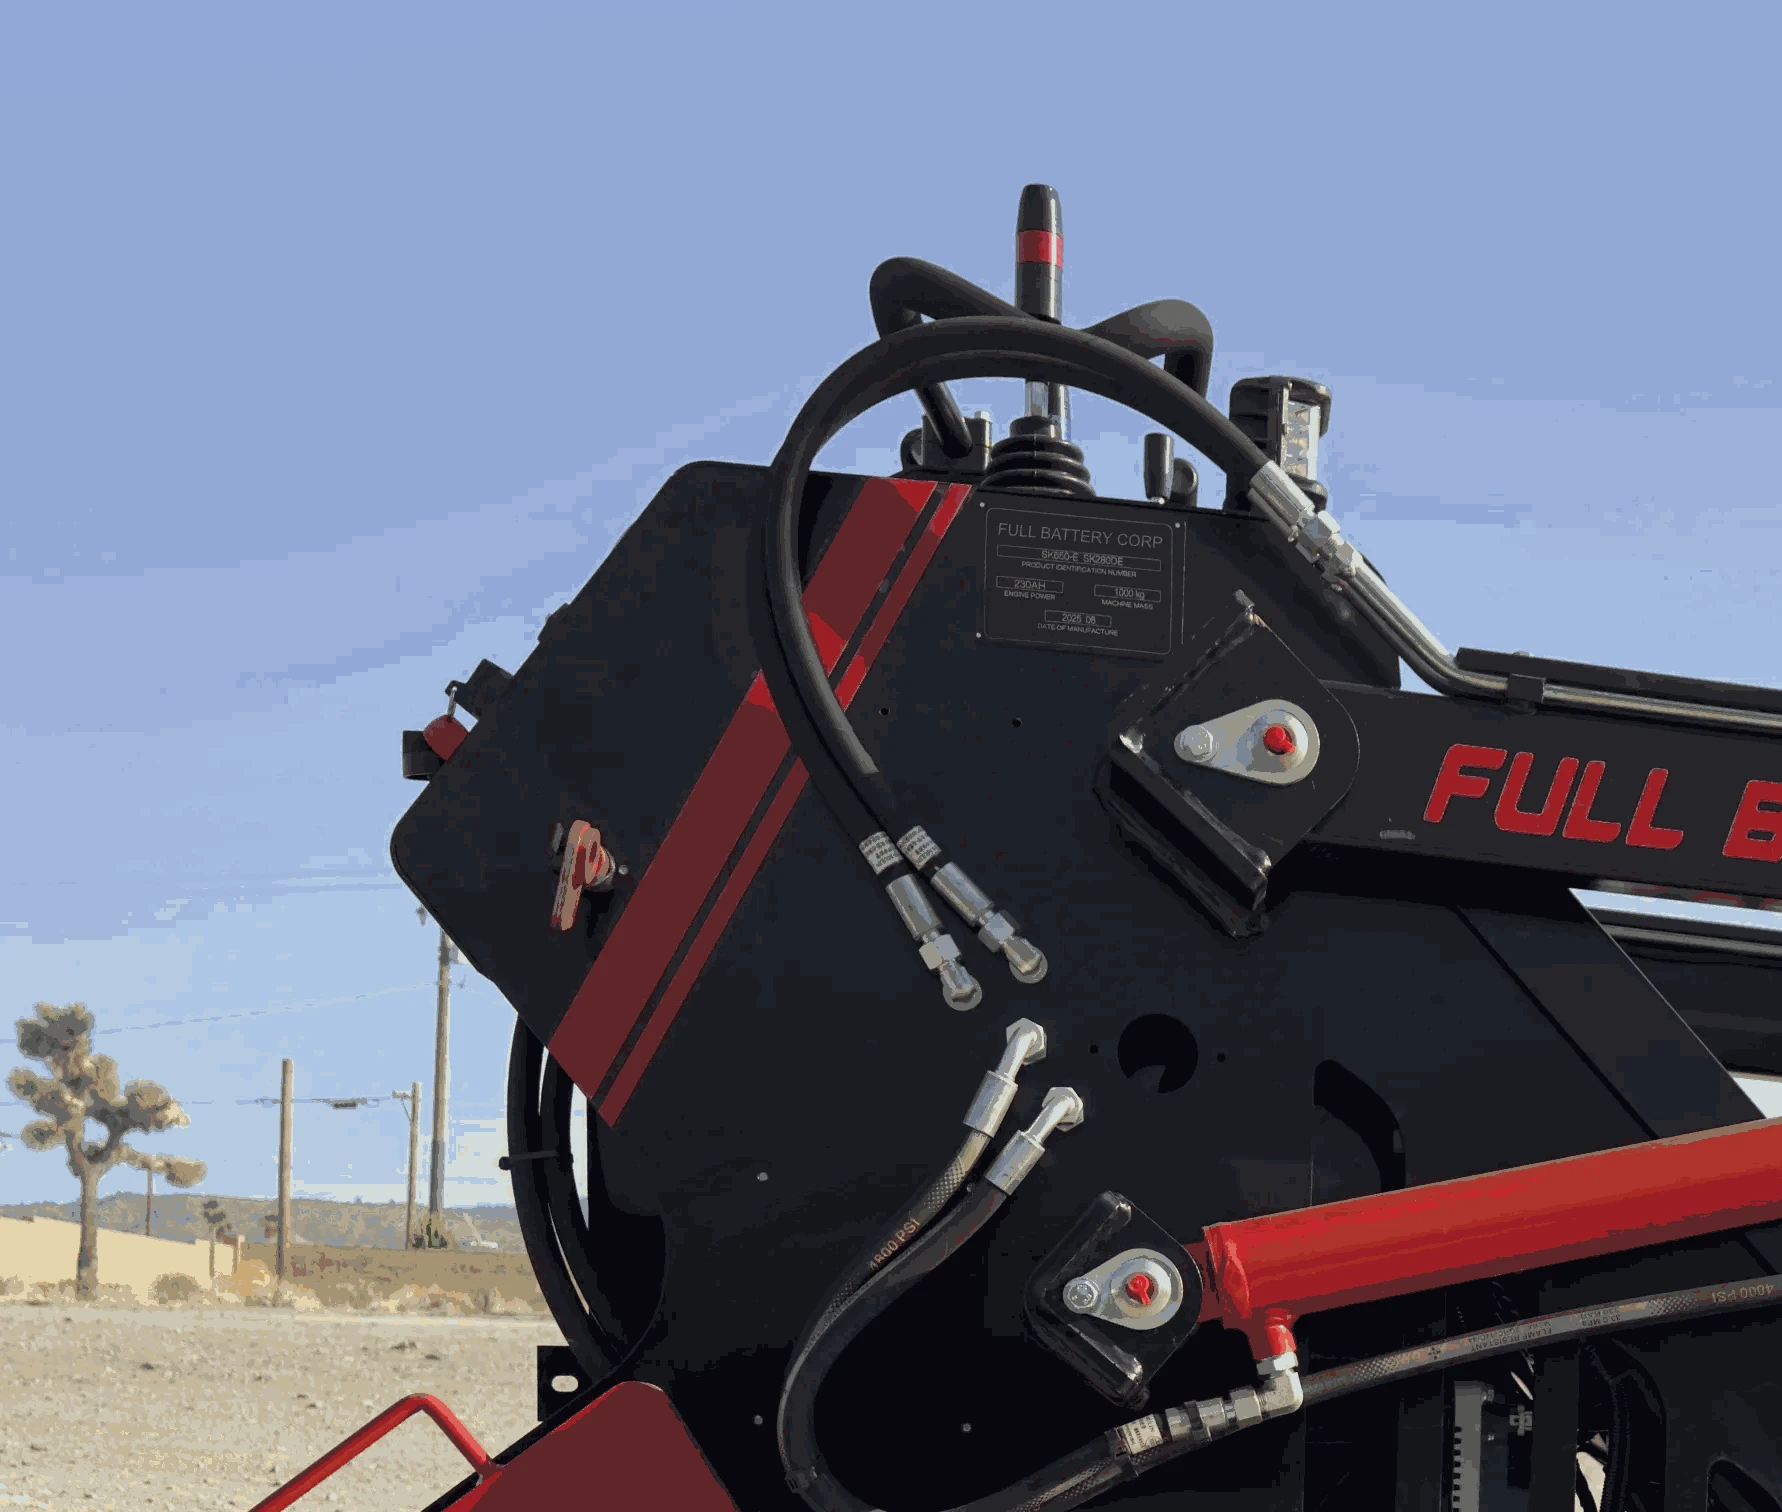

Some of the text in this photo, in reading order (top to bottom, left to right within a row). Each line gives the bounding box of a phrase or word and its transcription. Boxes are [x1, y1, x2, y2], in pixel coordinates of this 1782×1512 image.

[997, 522, 1163, 549] FULL BATTERY CORP
[1021, 561, 1137, 578] PRODUCT IDENTIFICATION NUMBER
[1014, 579, 1046, 590] 230AH
[1004, 590, 1056, 600] ENGINE POWER
[1114, 588, 1145, 601] 1000 kg
[1101, 599, 1154, 610] MACHINE MASS
[1037, 623, 1056, 631] DATE
[1067, 626, 1119, 637] MANUFACTURE
[1422, 743, 1685, 851] FULL
[895, 1217, 920, 1242] PSI
[1711, 1289, 1737, 1303] PSI
[1471, 1335, 1520, 1353] RESISTANT
